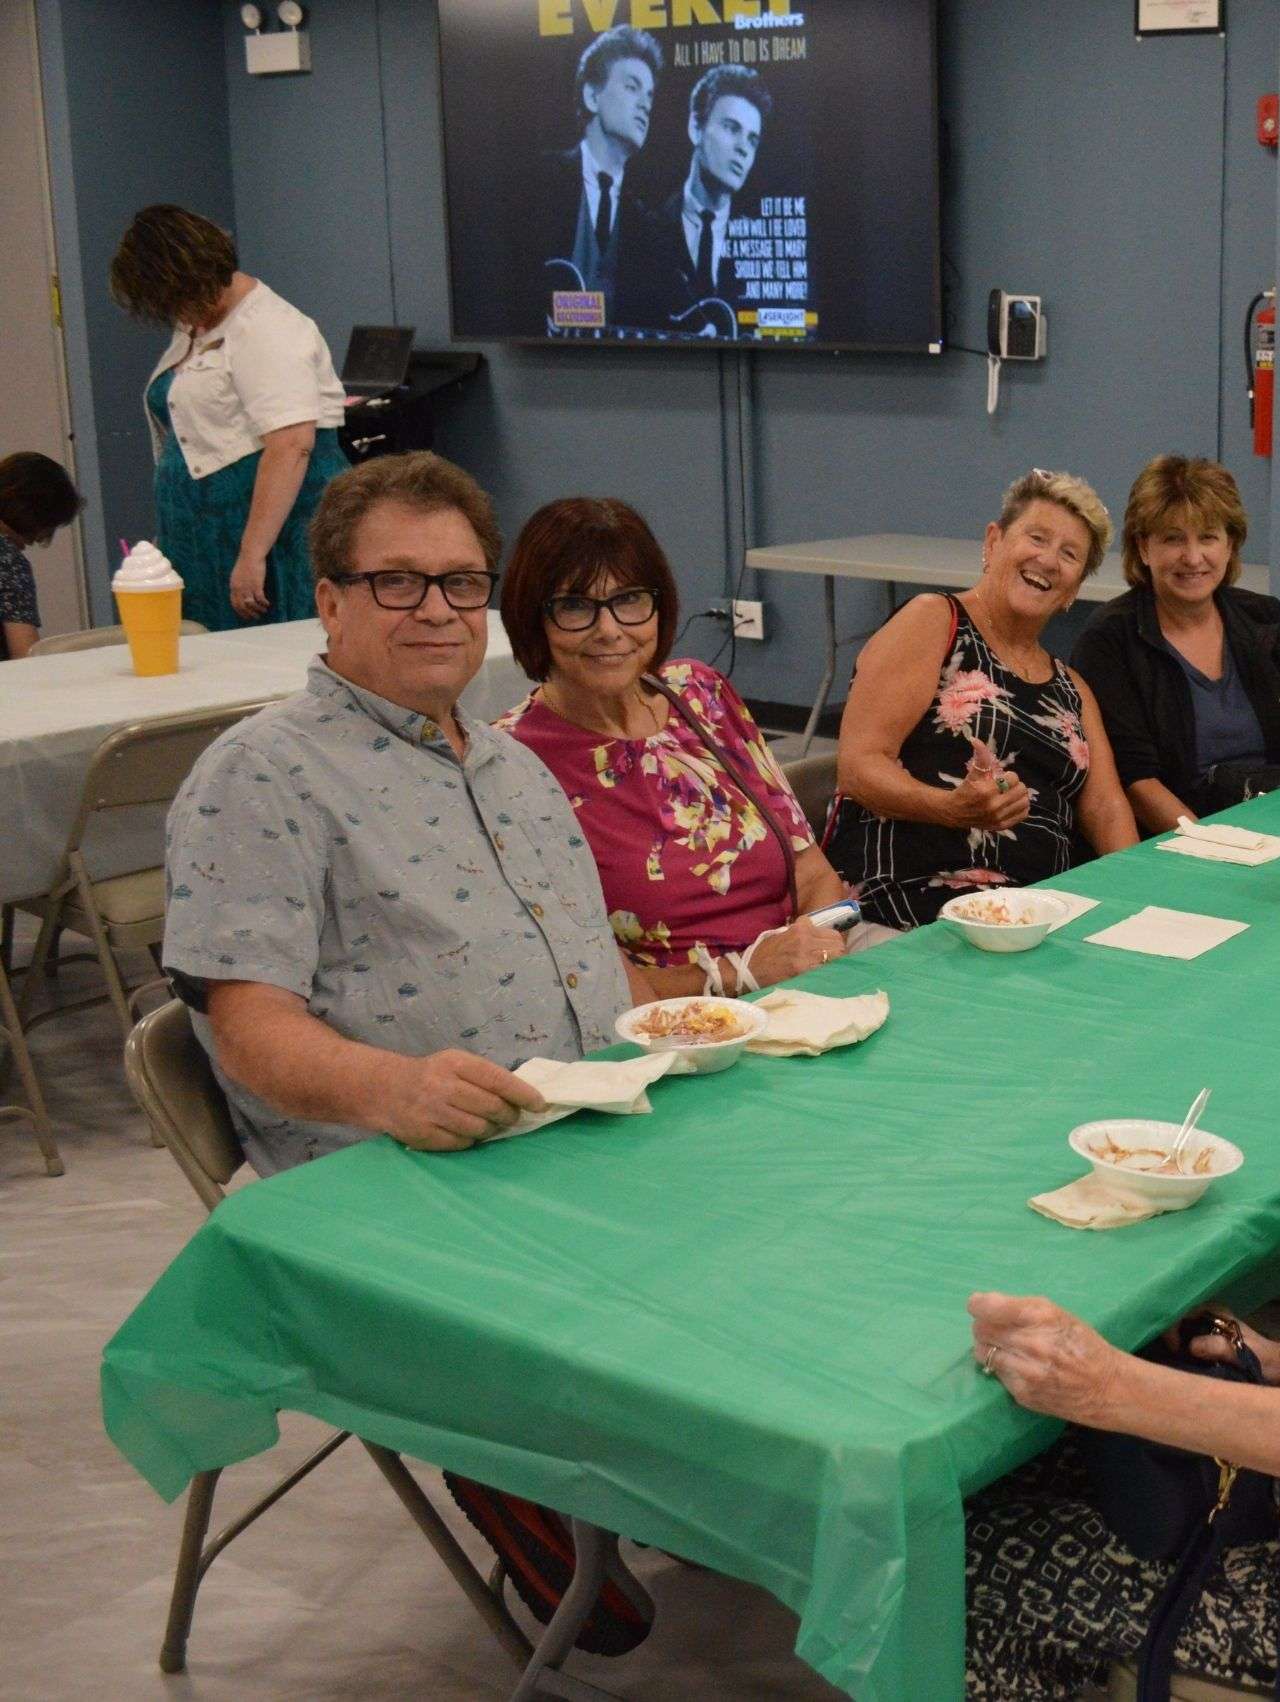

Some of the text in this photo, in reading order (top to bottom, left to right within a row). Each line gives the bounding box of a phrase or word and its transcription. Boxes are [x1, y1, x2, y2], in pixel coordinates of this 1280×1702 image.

[734, 10, 804, 30] Brothers
[674, 43, 690, 66] ALL
[701, 40, 724, 64] HAVE
[728, 38, 740, 62] TO
[742, 38, 757, 62] DO
[759, 37, 769, 61] IS
[771, 36, 806, 61] DREAM
[761, 197, 773, 216] LET
[783, 197, 793, 216] BE
[794, 197, 805, 216] ME
